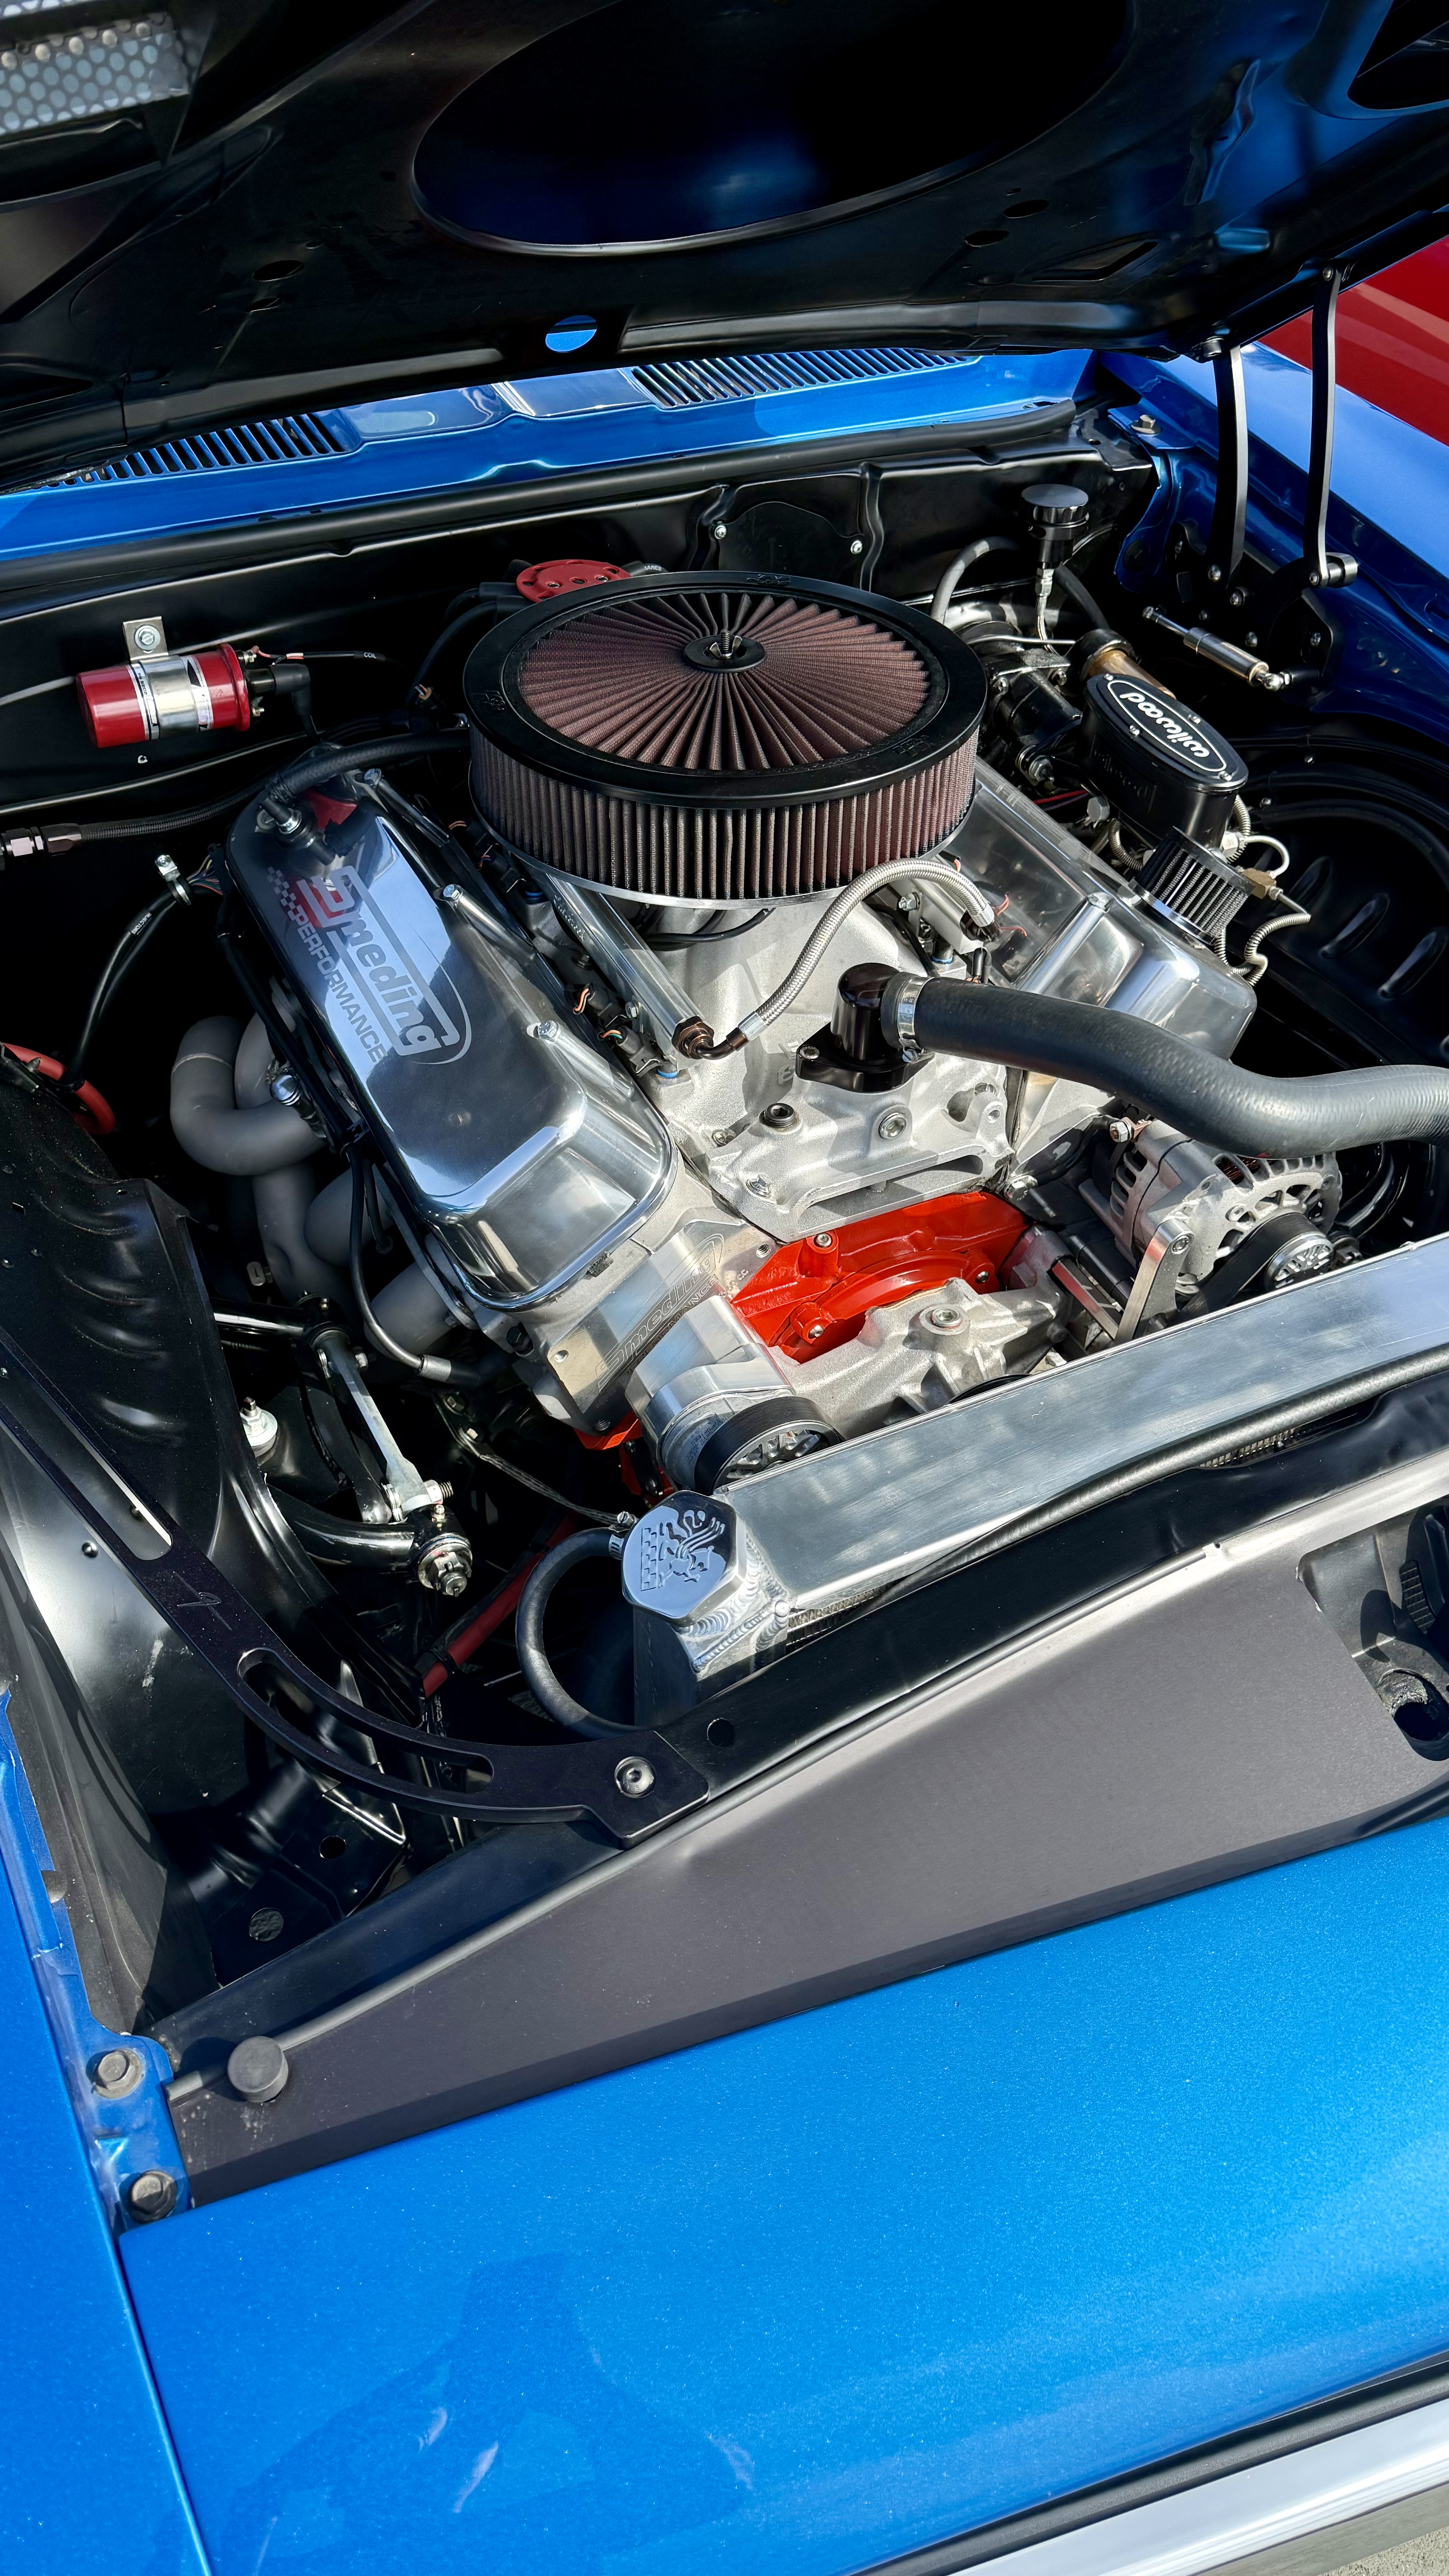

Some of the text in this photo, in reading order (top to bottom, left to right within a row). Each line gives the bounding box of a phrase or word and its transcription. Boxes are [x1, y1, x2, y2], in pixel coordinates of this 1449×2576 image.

[1119, 692, 1210, 758] wilwood
[290, 904, 389, 1063] PERFORMANCE
[296, 865, 460, 1057] Smeding
